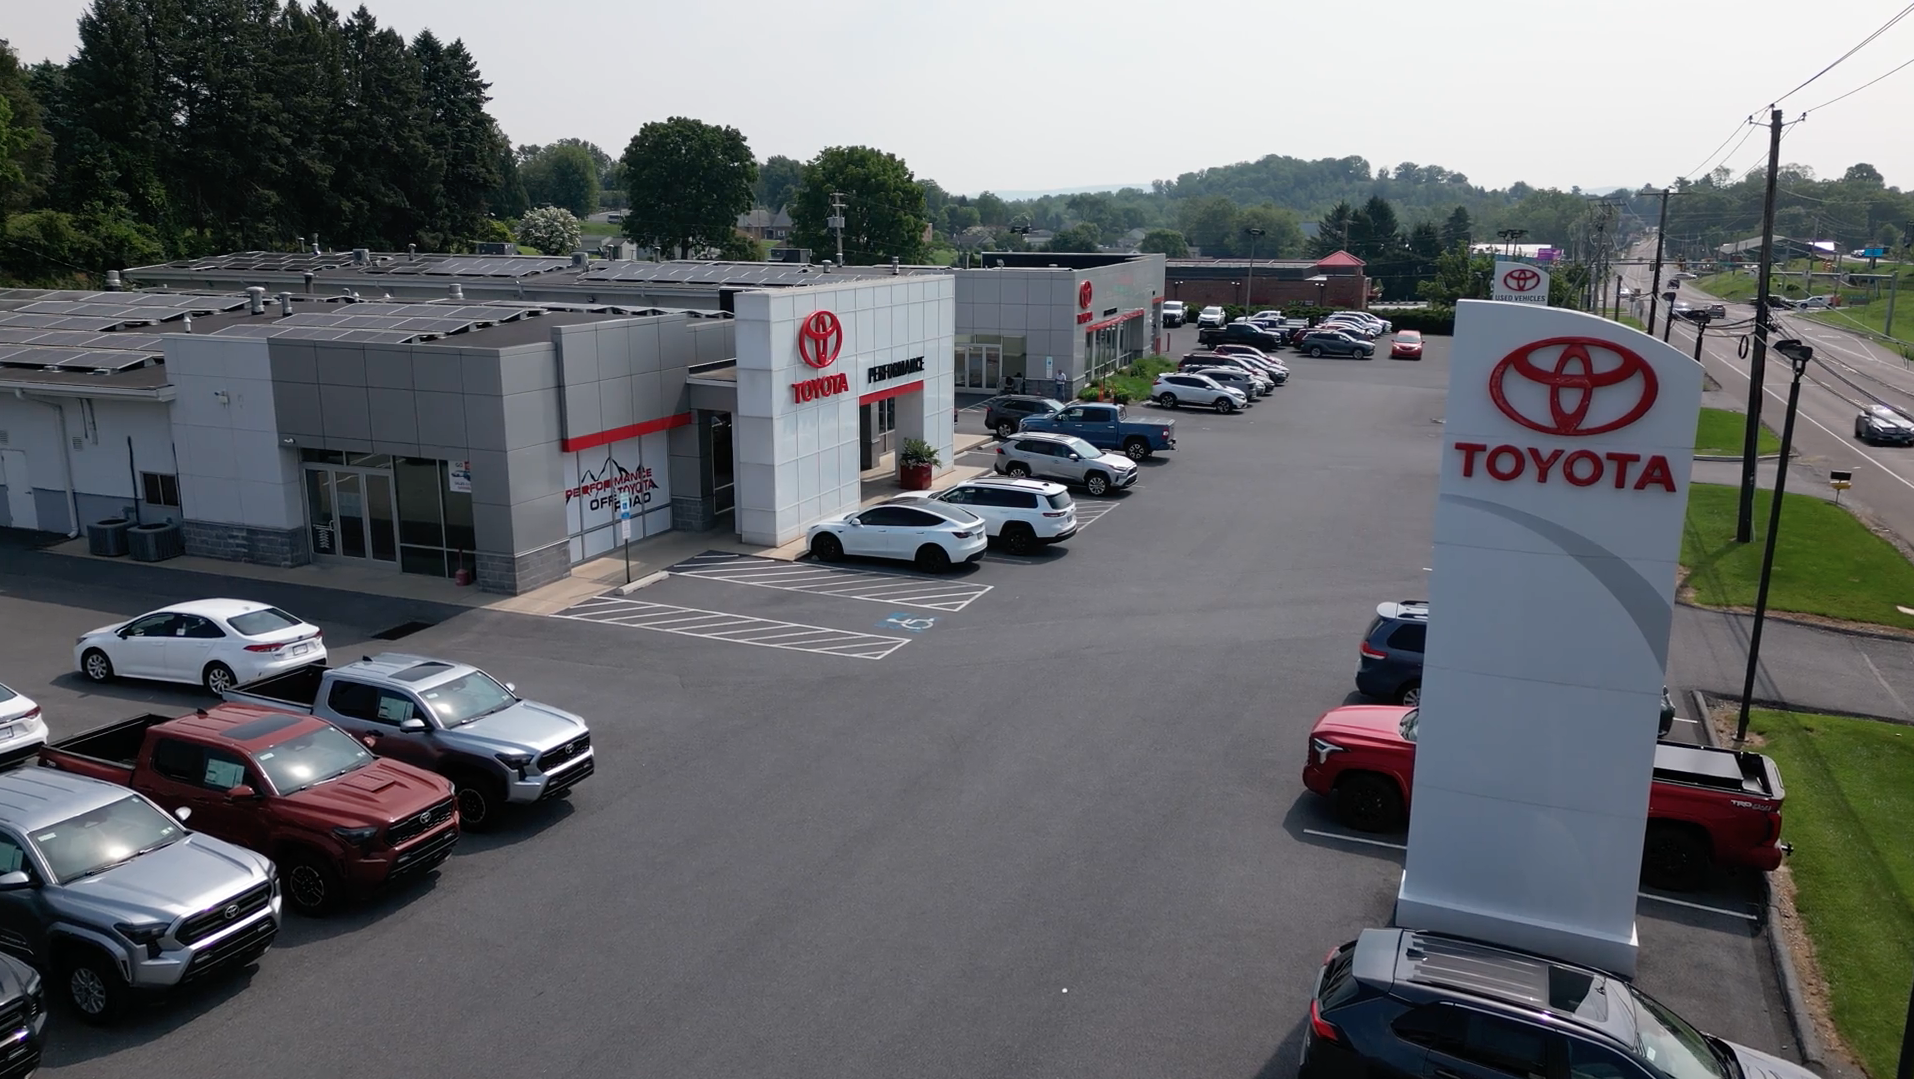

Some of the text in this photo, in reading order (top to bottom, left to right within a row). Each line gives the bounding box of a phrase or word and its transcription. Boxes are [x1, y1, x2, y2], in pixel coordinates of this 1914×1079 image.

[1514, 294, 1546, 302] VEHICLES
[868, 356, 924, 383] PERFORMANCE
[792, 372, 849, 404] TOYOTA
[1454, 442, 1677, 493] TOYOTA
